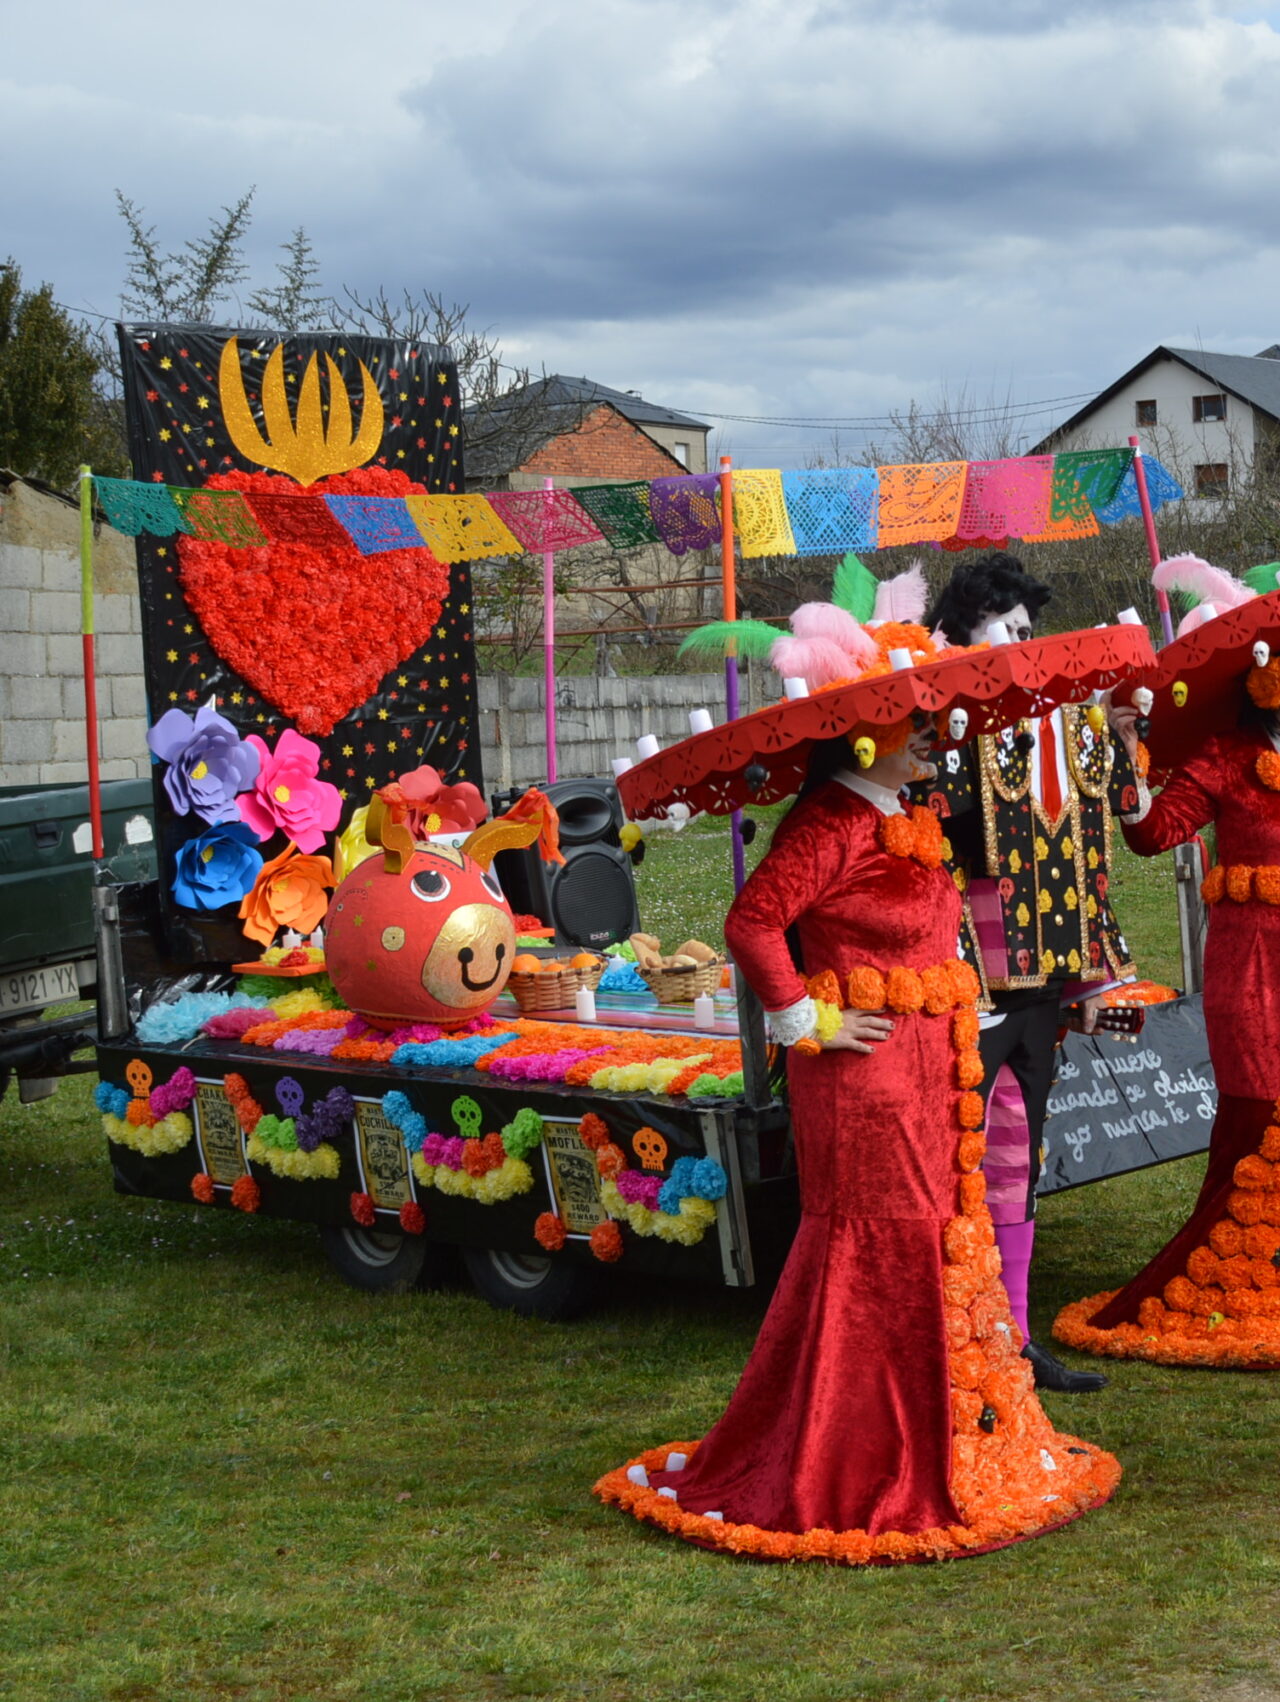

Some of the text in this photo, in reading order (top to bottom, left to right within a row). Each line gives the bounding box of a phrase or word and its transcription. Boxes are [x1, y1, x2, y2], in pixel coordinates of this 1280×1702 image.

[1058, 1048, 1162, 1080] se muere
[1046, 1068, 1216, 1114] cuando se olvida
[1064, 1124, 1092, 1163] yo
[1102, 1109, 1168, 1138] nunca
[1164, 1098, 1190, 1124] te
